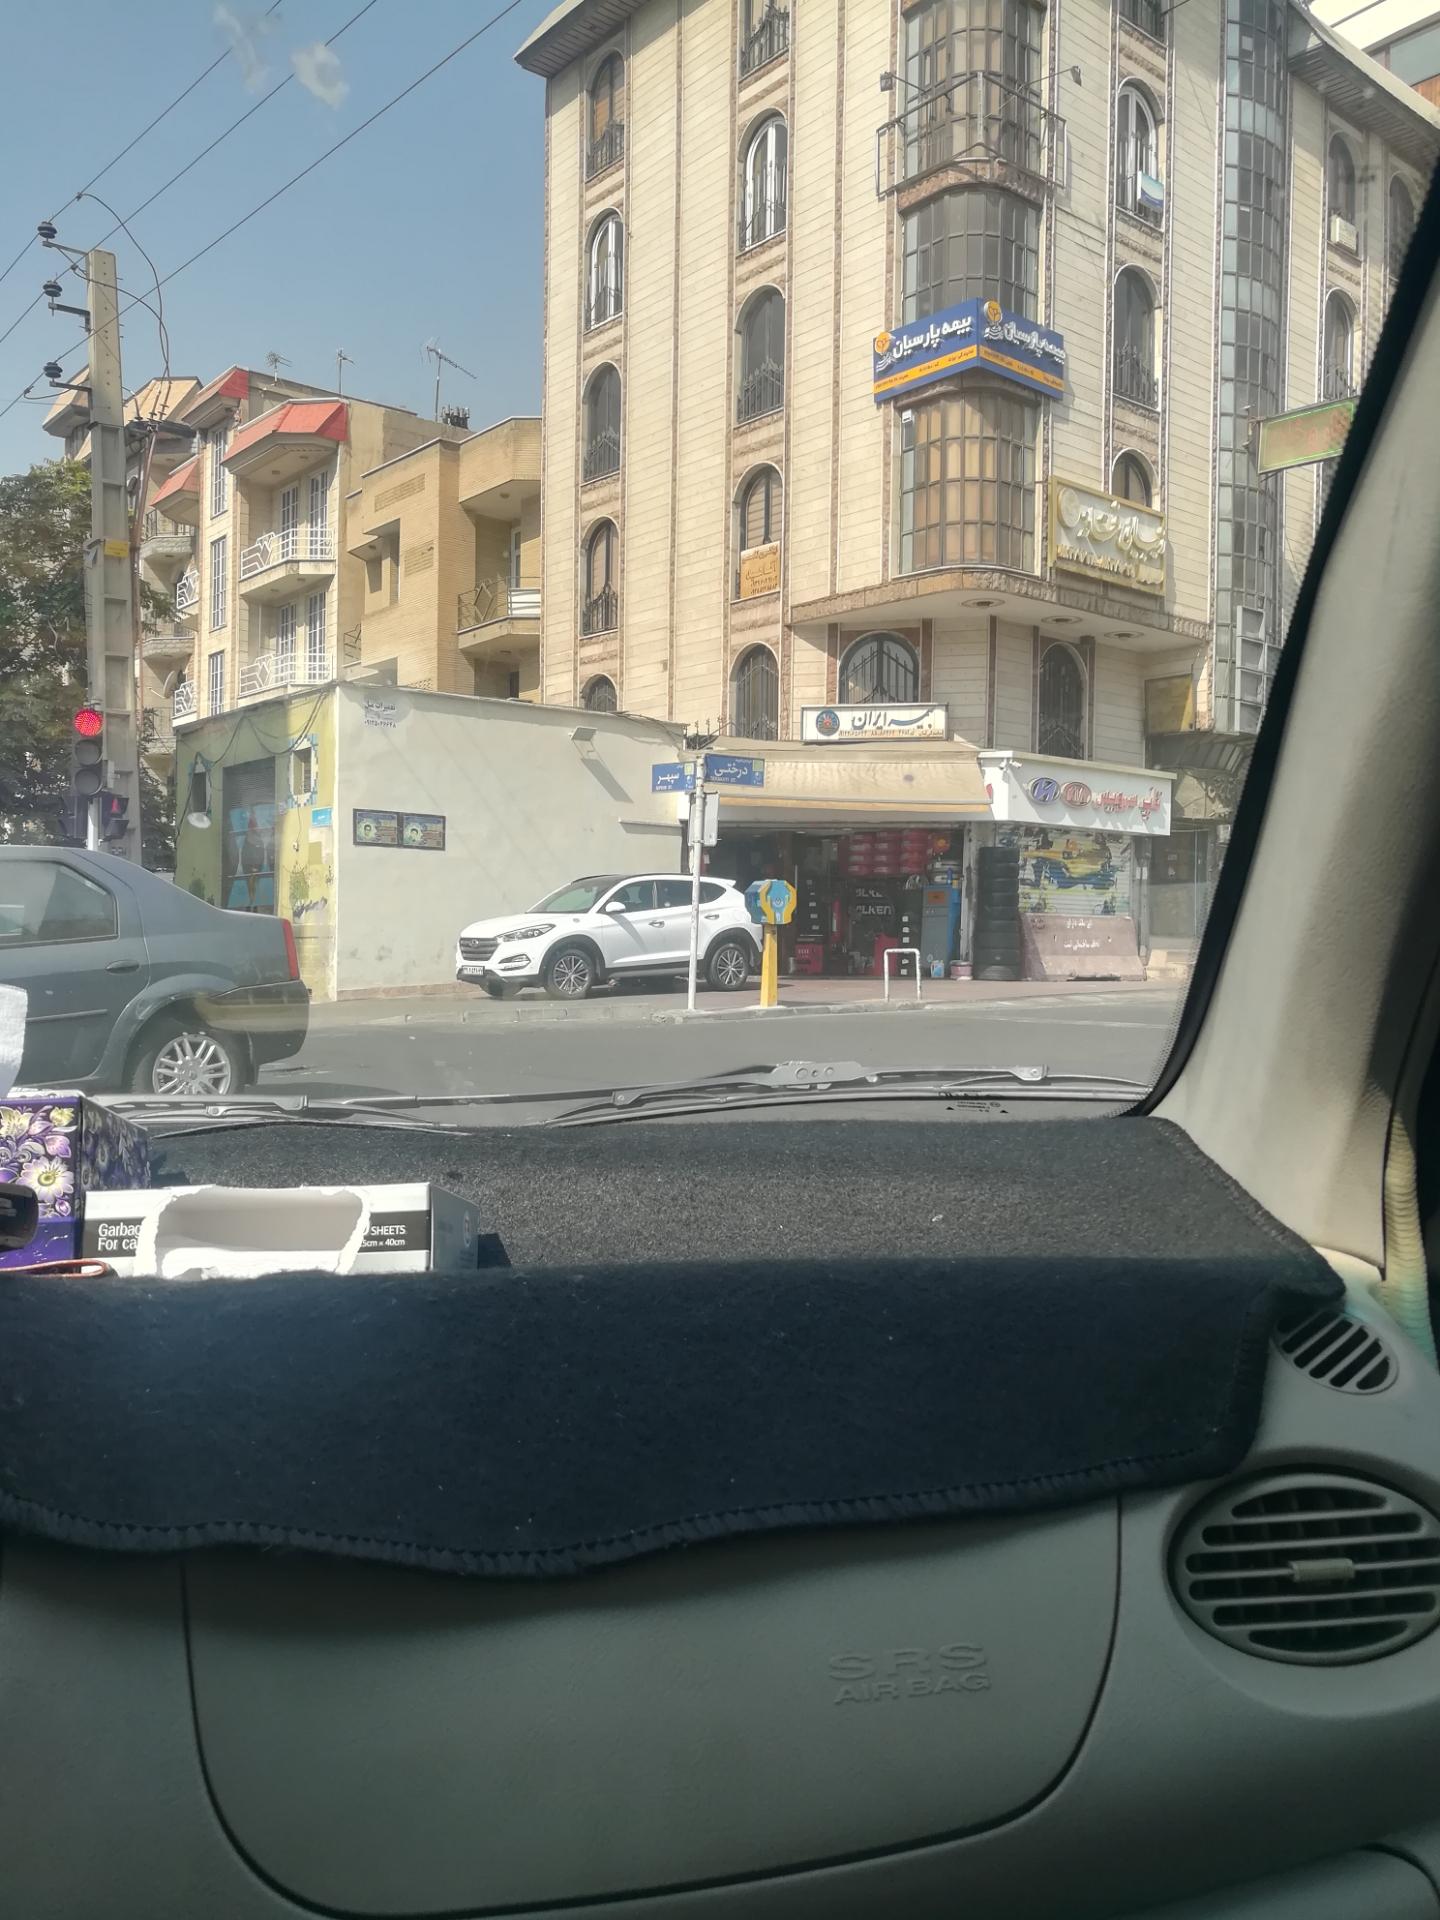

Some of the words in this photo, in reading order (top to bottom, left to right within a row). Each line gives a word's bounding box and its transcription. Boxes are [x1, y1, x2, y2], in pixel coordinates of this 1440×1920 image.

[941, 316, 972, 335] بیمه
[893, 324, 940, 359] پارسیان
[1003, 321, 1045, 358] پارسیان
[1042, 338, 1067, 365] بیمه
[851, 710, 887, 731] ایران
[887, 705, 937, 730] بیمه
[657, 772, 680, 785] سپهر
[714, 762, 748, 778] درختی
[98, 1221, 142, 1238] Garbag
[370, 1224, 407, 1236] SHEETS
[97, 1237, 118, 1251] For
[121, 1238, 138, 1250] ca
[384, 1238, 406, 1247] 40cm
[828, 1642, 988, 1681] SRS
